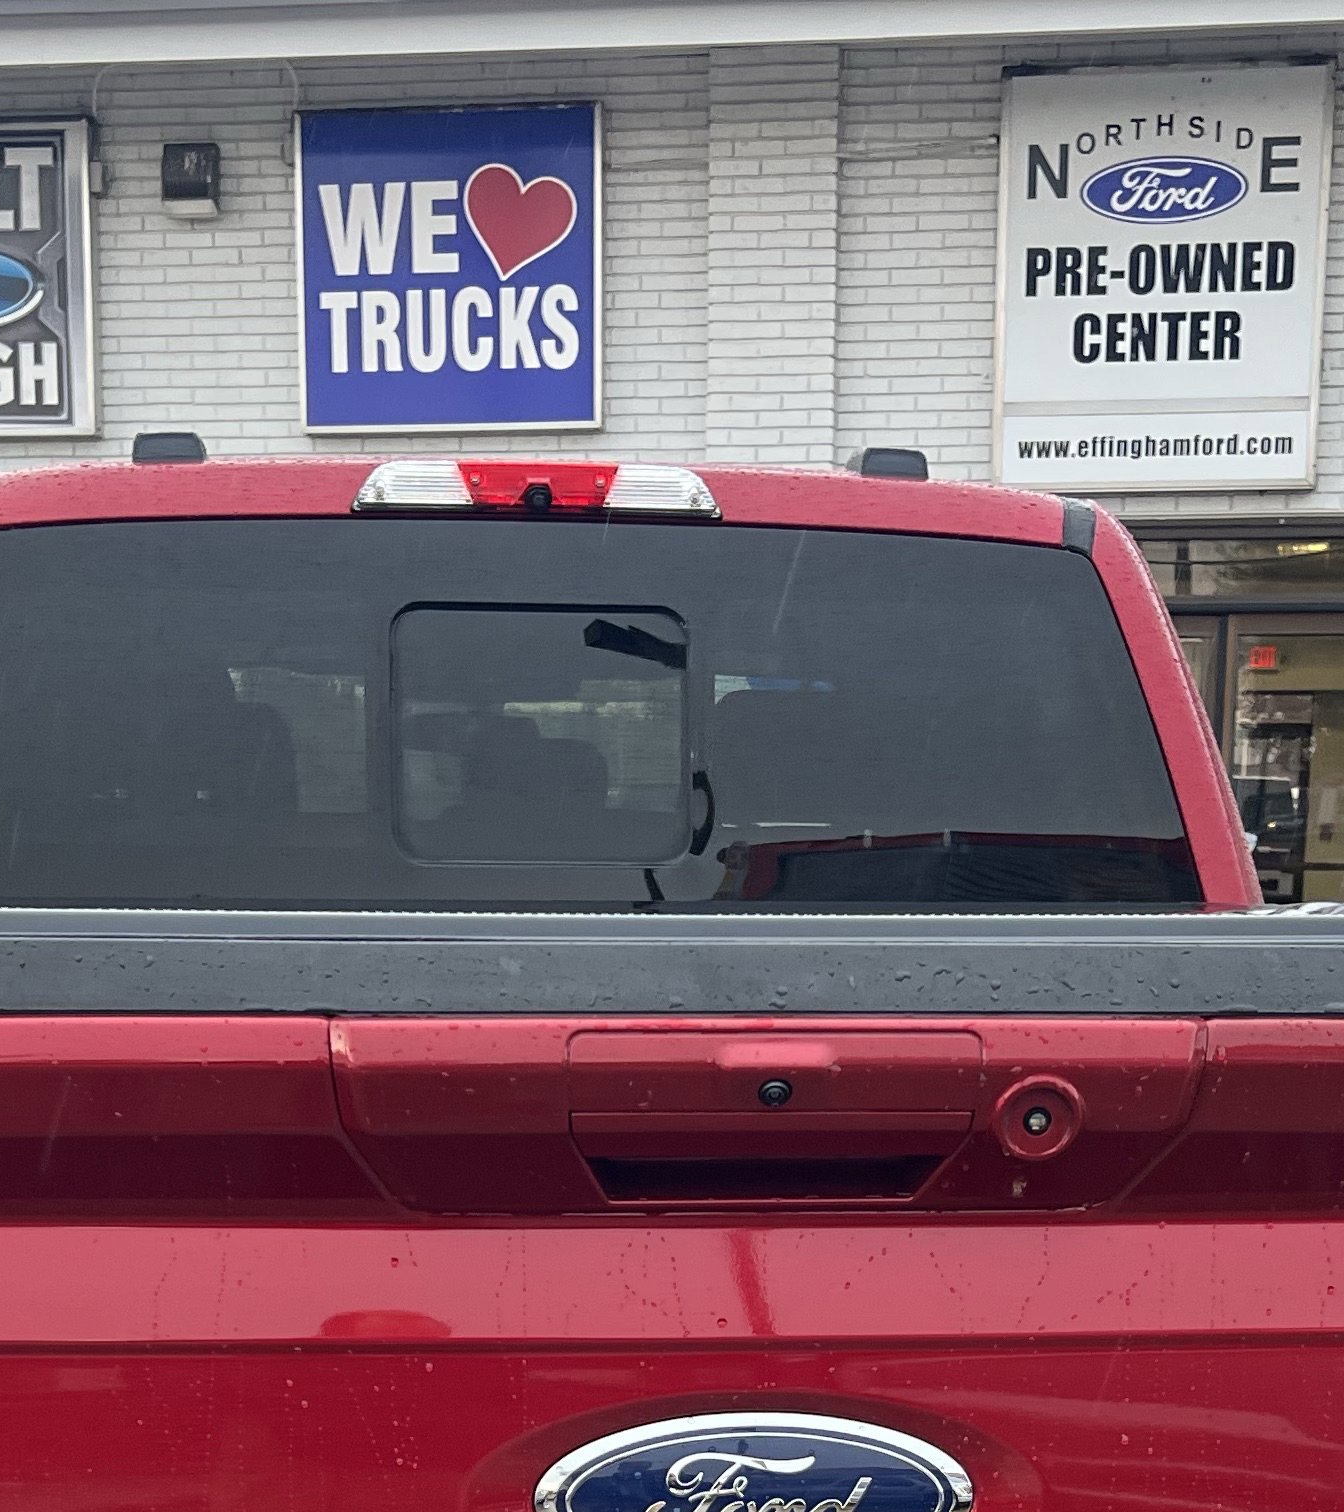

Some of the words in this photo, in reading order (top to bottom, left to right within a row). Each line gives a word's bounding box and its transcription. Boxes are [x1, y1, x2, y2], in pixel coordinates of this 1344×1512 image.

[1026, 114, 1302, 200] NORTHSIDE
[1109, 165, 1218, 213] Ford
[317, 179, 460, 276] WE
[1024, 241, 1296, 298] PRE-OWNED
[318, 283, 580, 374] TRUCKS
[1072, 310, 1241, 364] CENTER
[1017, 433, 1294, 461] www.effinghamford.com
